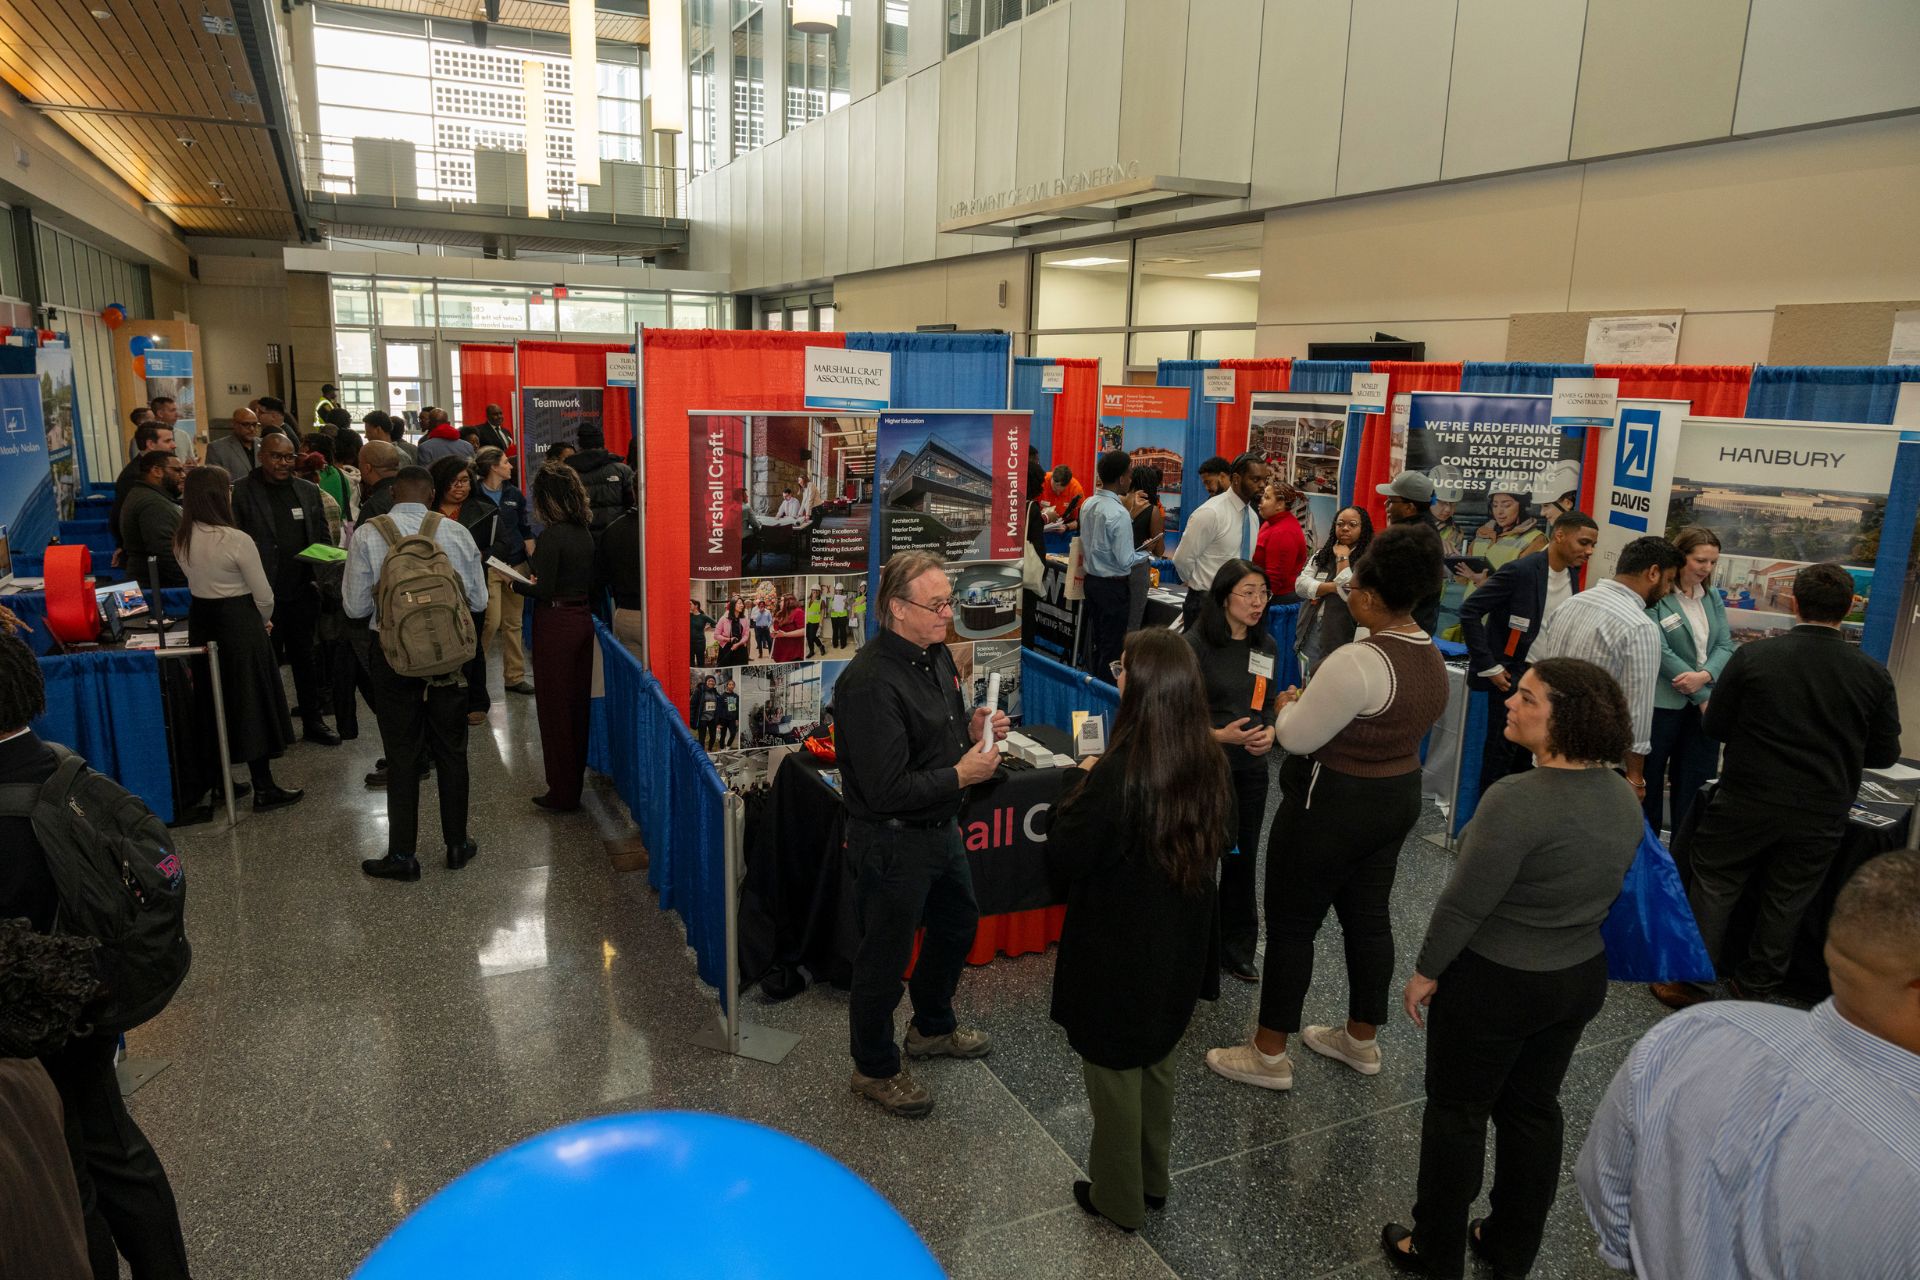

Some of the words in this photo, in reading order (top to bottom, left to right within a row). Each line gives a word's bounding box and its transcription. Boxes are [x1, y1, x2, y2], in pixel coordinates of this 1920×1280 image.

[951, 192, 1006, 219] DEPARTMENT
[1054, 160, 1139, 196] ENGINEERING
[814, 364, 856, 374] MARSHALL
[858, 368, 883, 376] CRAFT
[817, 375, 864, 386] ASSOCIATES,
[865, 378, 880, 386] INC.
[532, 398, 580, 408] Teamwork
[1105, 394, 1124, 404] WT
[1425, 420, 1469, 431] WE’RE
[1473, 423, 1562, 434] REDEFINING
[1436, 433, 1464, 442] THE
[1468, 434, 1502, 444] WAY
[1506, 436, 1560, 447] PEOPLE
[20, 442, 40, 453] Nolan
[1469, 446, 1559, 458] EXPERIENCE
[1440, 456, 1557, 470] CONSTRUCTION
[1720, 447, 1845, 468] HANBURY
[1463, 469, 1482, 478] BY
[1485, 470, 1556, 482] BUILDING
[1490, 481, 1519, 491] FOR
[1523, 483, 1554, 494] ALL.
[1007, 472, 1018, 537] Marshall
[1611, 491, 1650, 512] DAVIS
[709, 481, 723, 554] Marshall
[958, 808, 1014, 850] all
[1023, 802, 1050, 843] C
